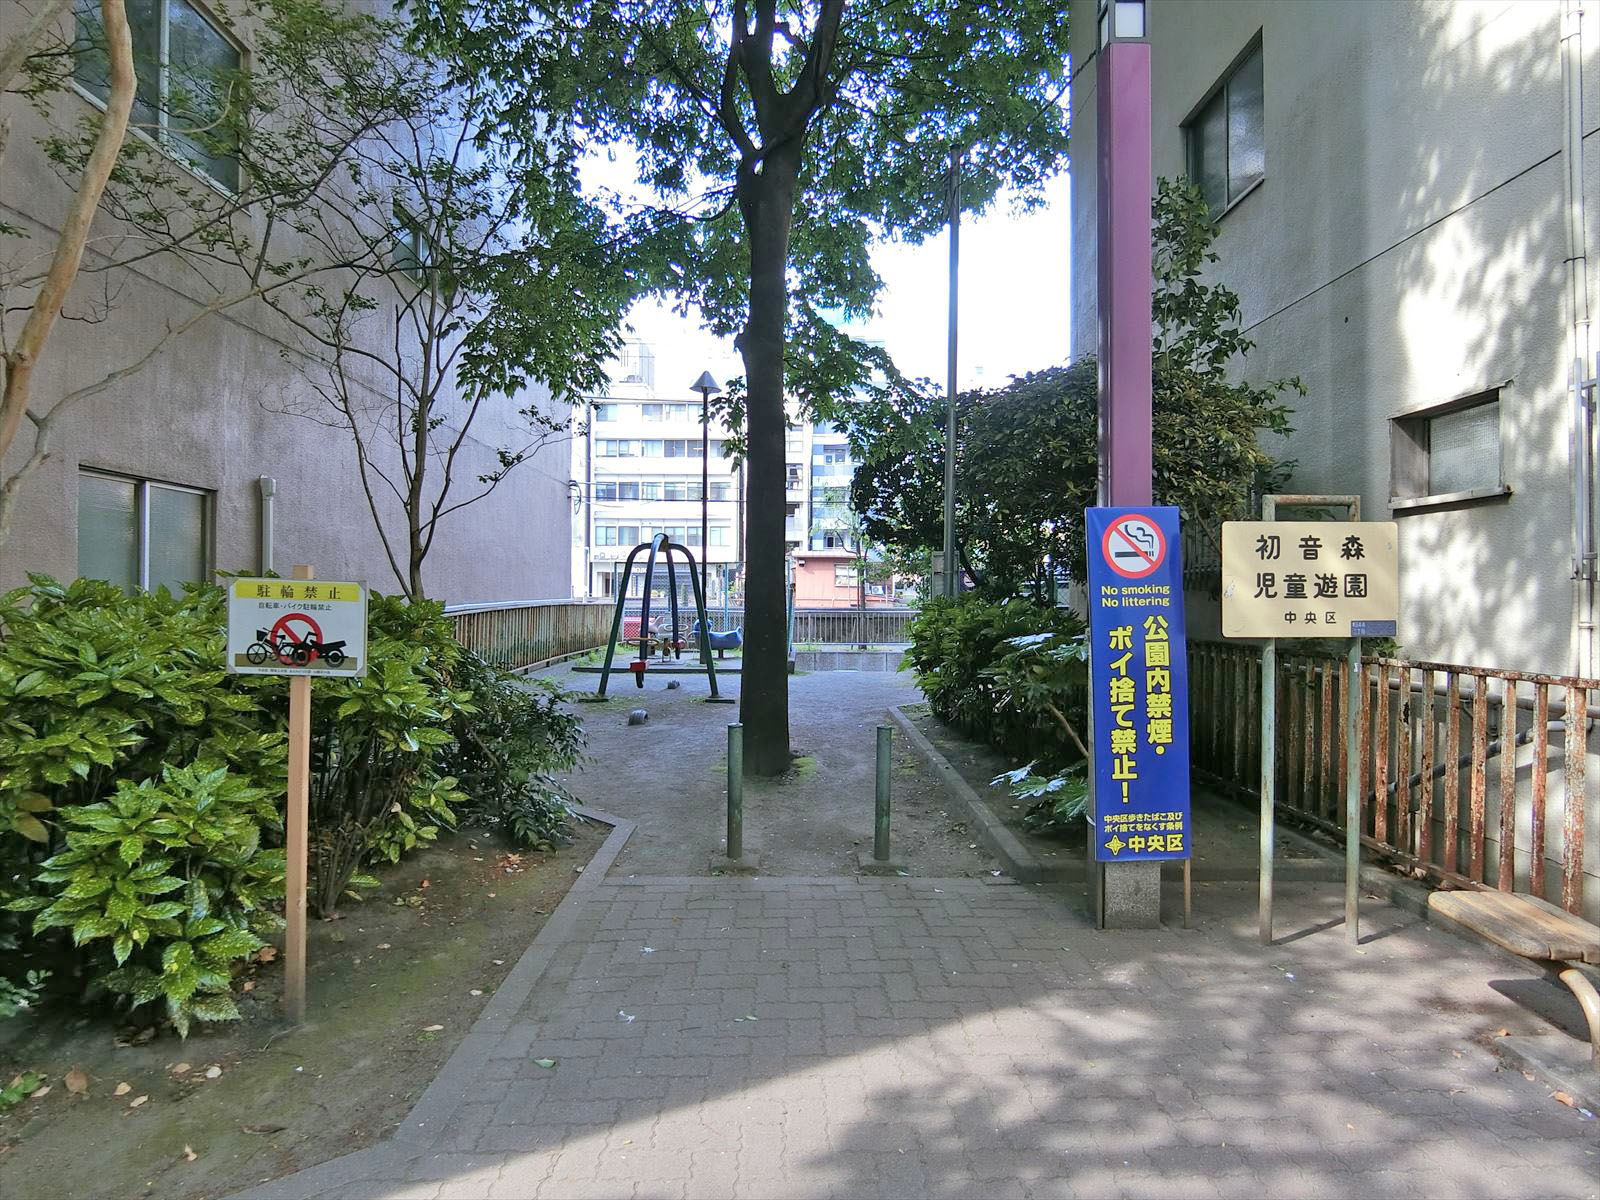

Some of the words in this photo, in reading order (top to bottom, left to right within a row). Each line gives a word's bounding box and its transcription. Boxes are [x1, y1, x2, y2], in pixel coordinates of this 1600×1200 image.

[1255, 534, 1366, 560] 初音森
[256, 584, 341, 600] 駐輪禁止
[1101, 585, 1118, 595] No
[1121, 584, 1170, 595] smoking
[1254, 572, 1368, 599] 児童遊園
[1101, 597, 1119, 607] No
[1122, 596, 1170, 607] littering
[1284, 611, 1337, 624] 中央区
[1104, 821, 1183, 833] ポイ捨てをなくす条例
[1128, 834, 1184, 853] 中央区
